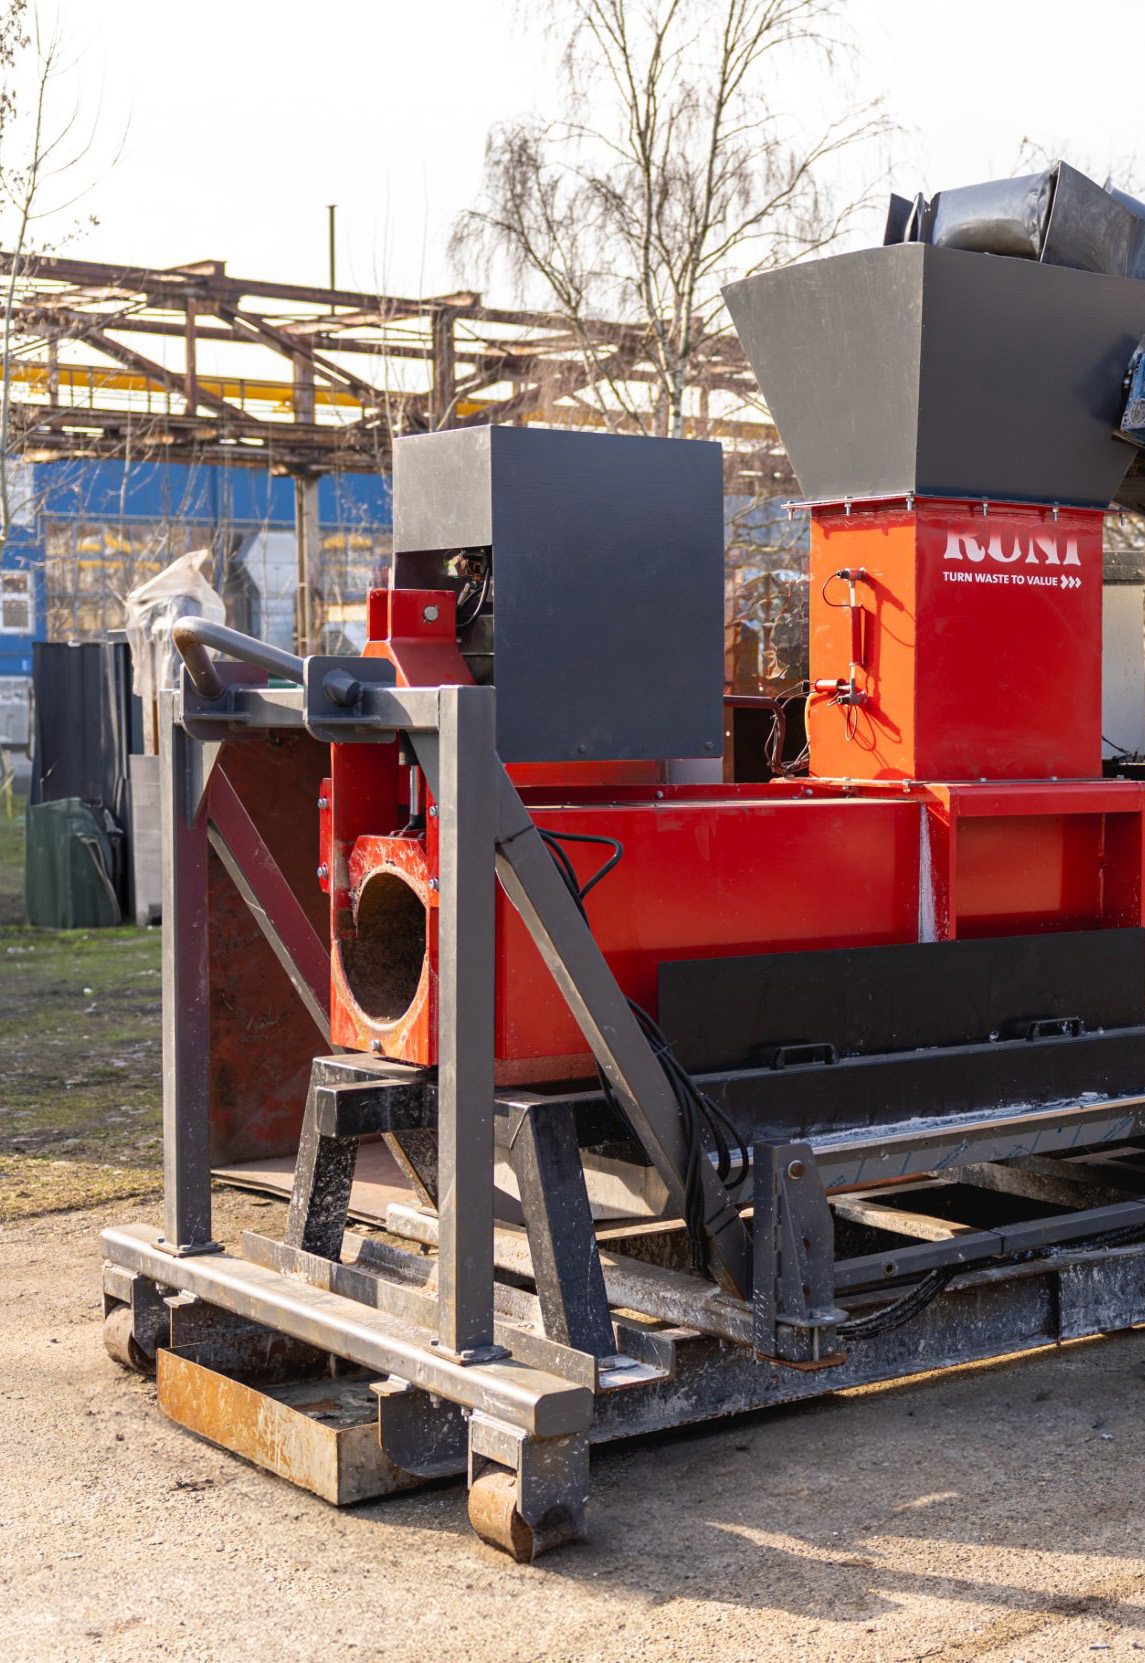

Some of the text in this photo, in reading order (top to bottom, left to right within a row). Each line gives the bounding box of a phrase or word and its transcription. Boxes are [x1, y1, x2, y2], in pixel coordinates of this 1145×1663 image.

[943, 571, 1058, 586] TURN WASTE TO VALUE
